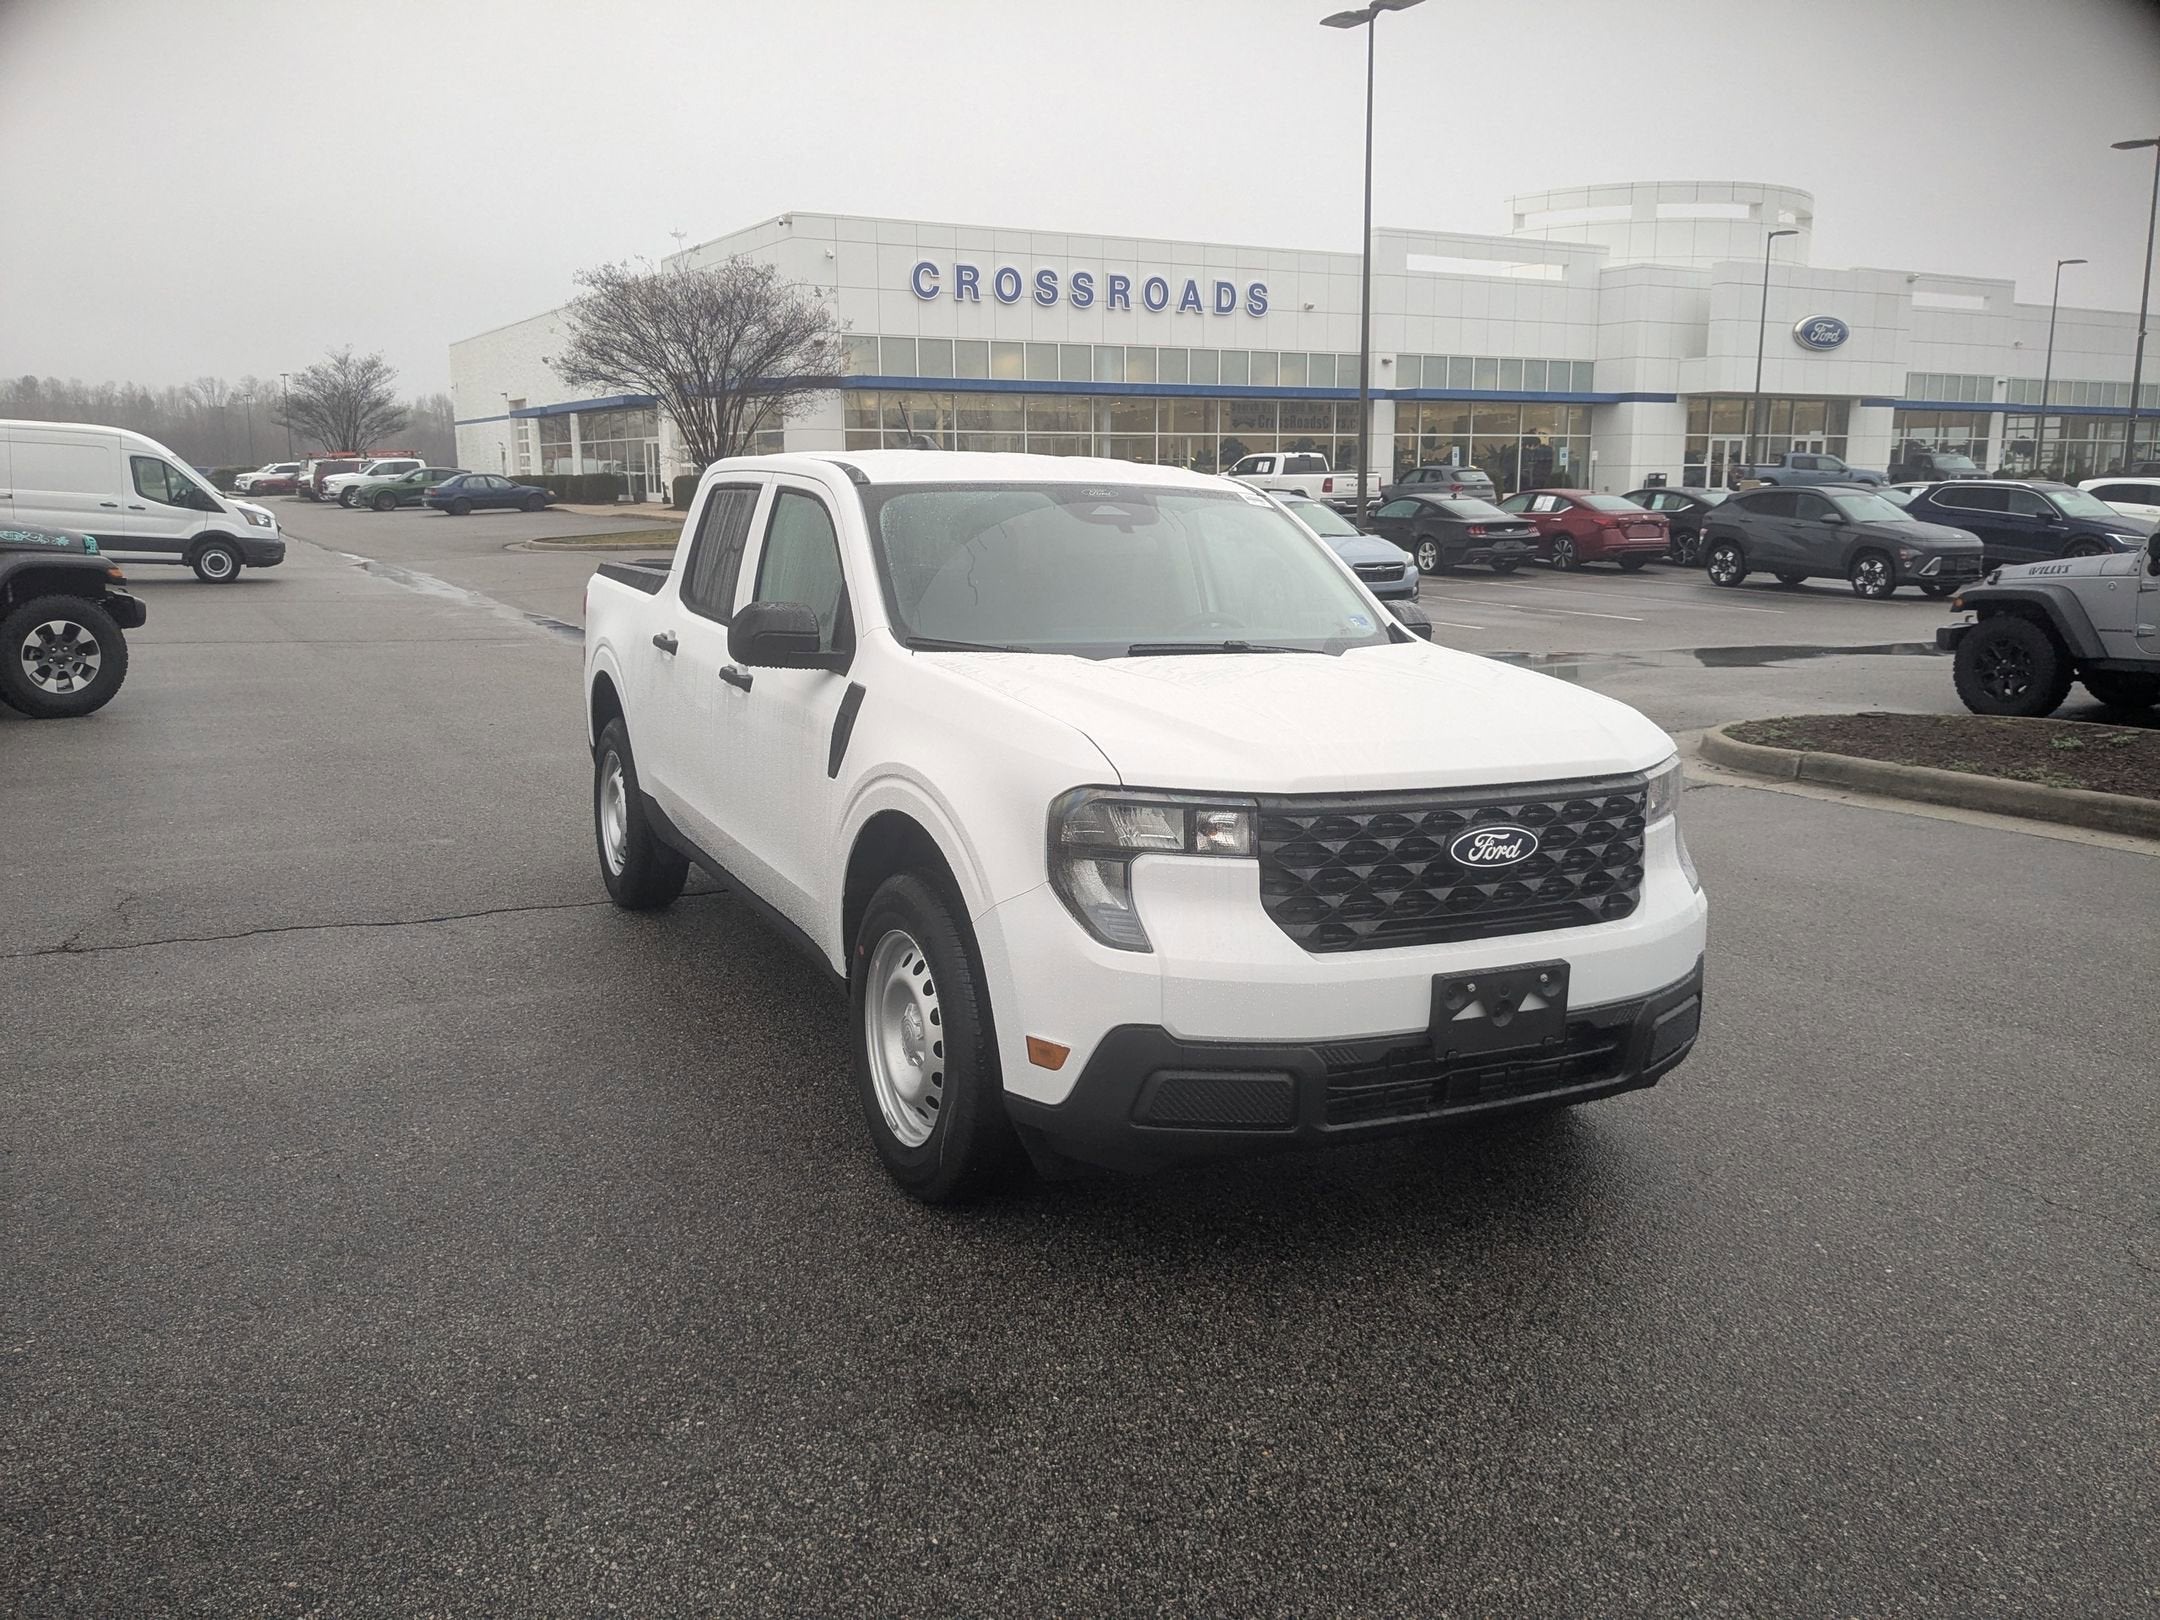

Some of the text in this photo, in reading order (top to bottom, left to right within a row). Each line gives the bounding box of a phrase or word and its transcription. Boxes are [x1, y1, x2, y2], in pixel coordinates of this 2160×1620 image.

[911, 260, 1270, 318] CROSSROADS
[1810, 322, 1841, 342] Ford
[2028, 564, 2073, 576] WILLYS
[1468, 833, 1523, 862] Ford
